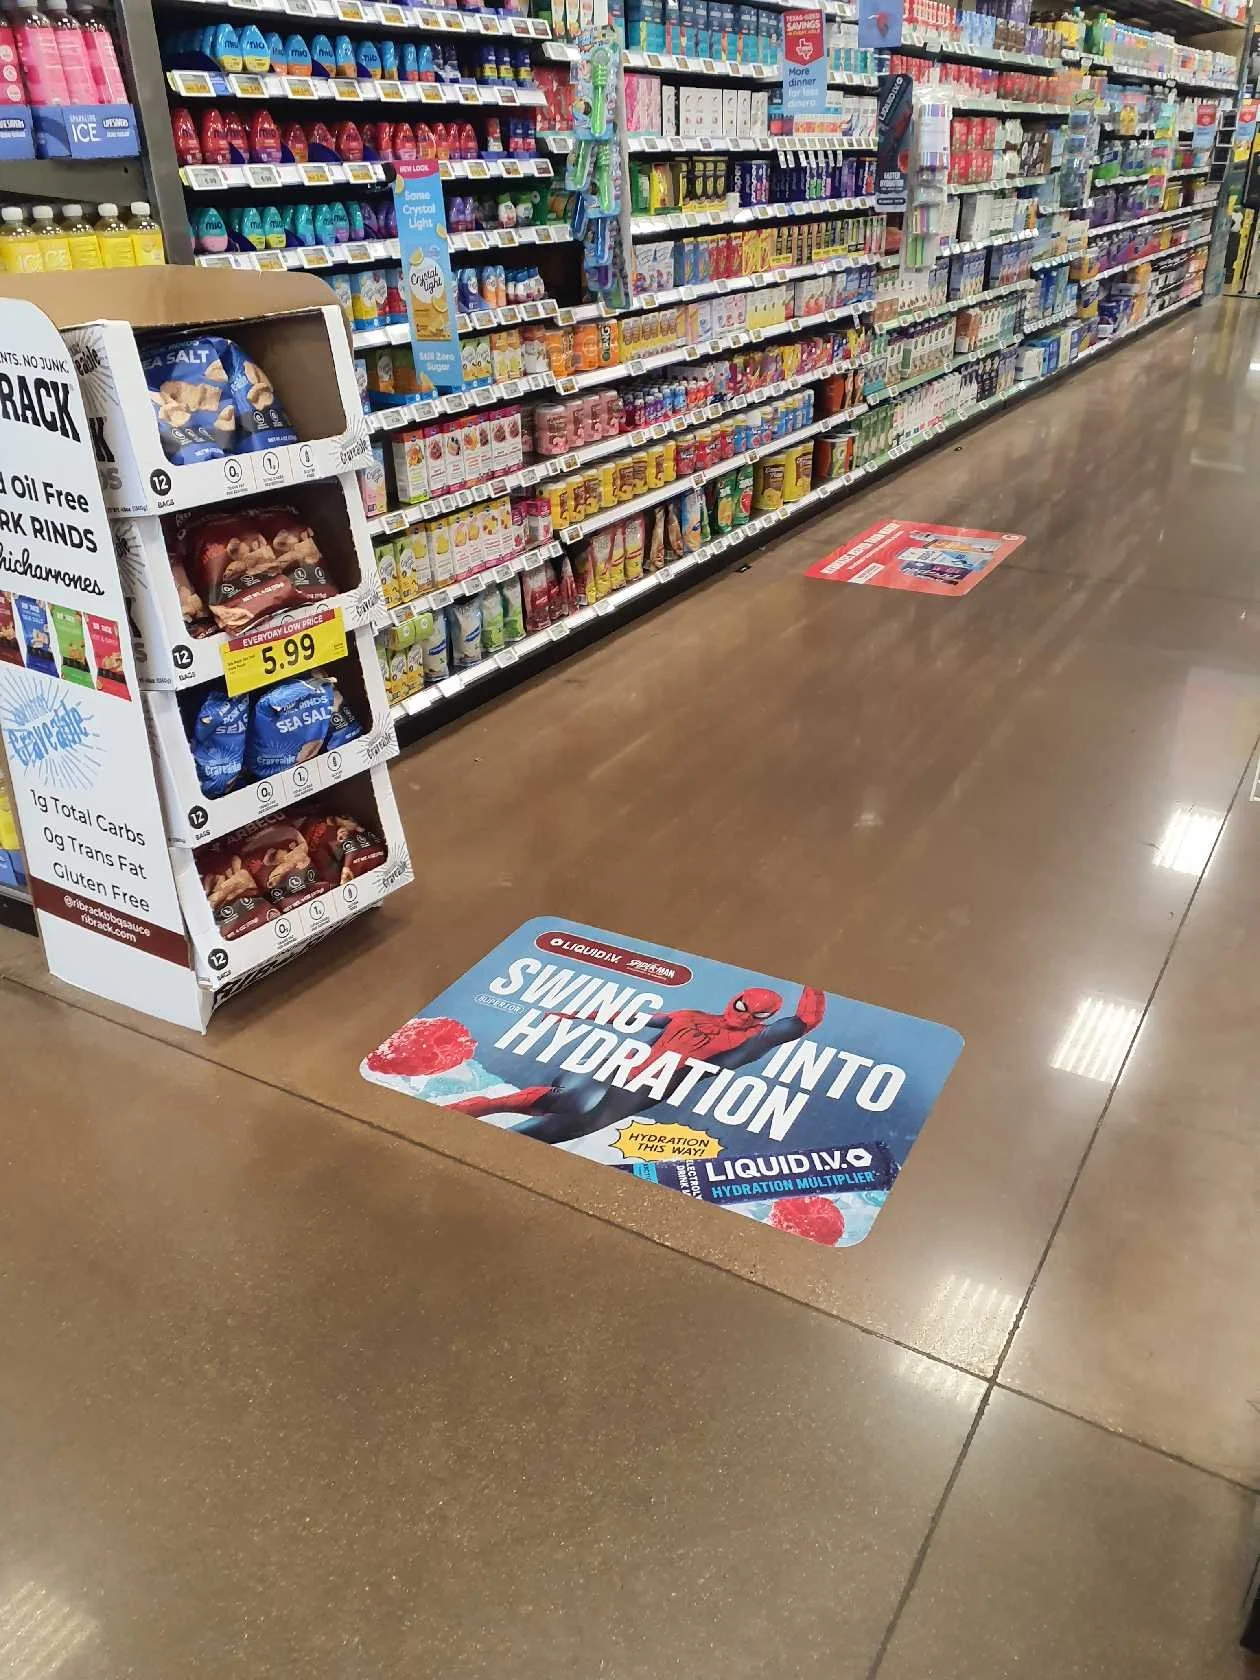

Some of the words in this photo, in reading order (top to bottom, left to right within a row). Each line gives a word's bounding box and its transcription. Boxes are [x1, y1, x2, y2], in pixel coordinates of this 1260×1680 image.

[786, 21, 821, 32] SAVINGS
[788, 67, 810, 77] More
[788, 77, 817, 88] dinner
[73, 122, 102, 144] ICE
[402, 203, 437, 216] Crystal
[408, 216, 434, 231] Light
[410, 265, 440, 288] Crystal
[422, 278, 444, 296] light
[22, 354, 38, 369] NO
[166, 350, 210, 366] SALT
[0, 372, 82, 443] RACK
[11, 474, 39, 502] Oil
[42, 481, 89, 513] Free
[150, 475, 171, 492] 12
[157, 499, 176, 509] BAGS
[29, 515, 98, 553] RINDS
[242, 628, 283, 648] EVERYDAY
[283, 622, 301, 635] LOW
[302, 614, 324, 630] PRICE
[174, 650, 192, 665] 12
[262, 633, 315, 675] 5.99
[276, 713, 303, 734] SEA
[30, 789, 49, 813] 1g
[50, 796, 93, 827] Total
[96, 814, 146, 847] Carbs
[190, 810, 205, 825] 12
[67, 835, 115, 867] Trans
[117, 854, 148, 880] Fat
[52, 862, 108, 897] Gluten
[111, 884, 151, 913] Free
[63, 894, 151, 938] @ribrackbbqsauce
[80, 912, 138, 943] ribrack.com
[210, 952, 227, 967] 12
[561, 941, 607, 961] LIQUID
[603, 951, 623, 964] I.V.
[489, 956, 664, 1034] SWING
[492, 1006, 811, 1143] HYDRATION
[761, 1039, 907, 1114] INTO
[628, 1132, 710, 1149] HYDRATION
[636, 1142, 666, 1154] THIS
[670, 1145, 706, 1158] WAY!
[704, 1152, 809, 1182] LIQUID
[815, 1149, 848, 1172] I.V.
[711, 1178, 794, 1200] HYDRATION
[798, 1170, 876, 1189] MULTIPLIER
